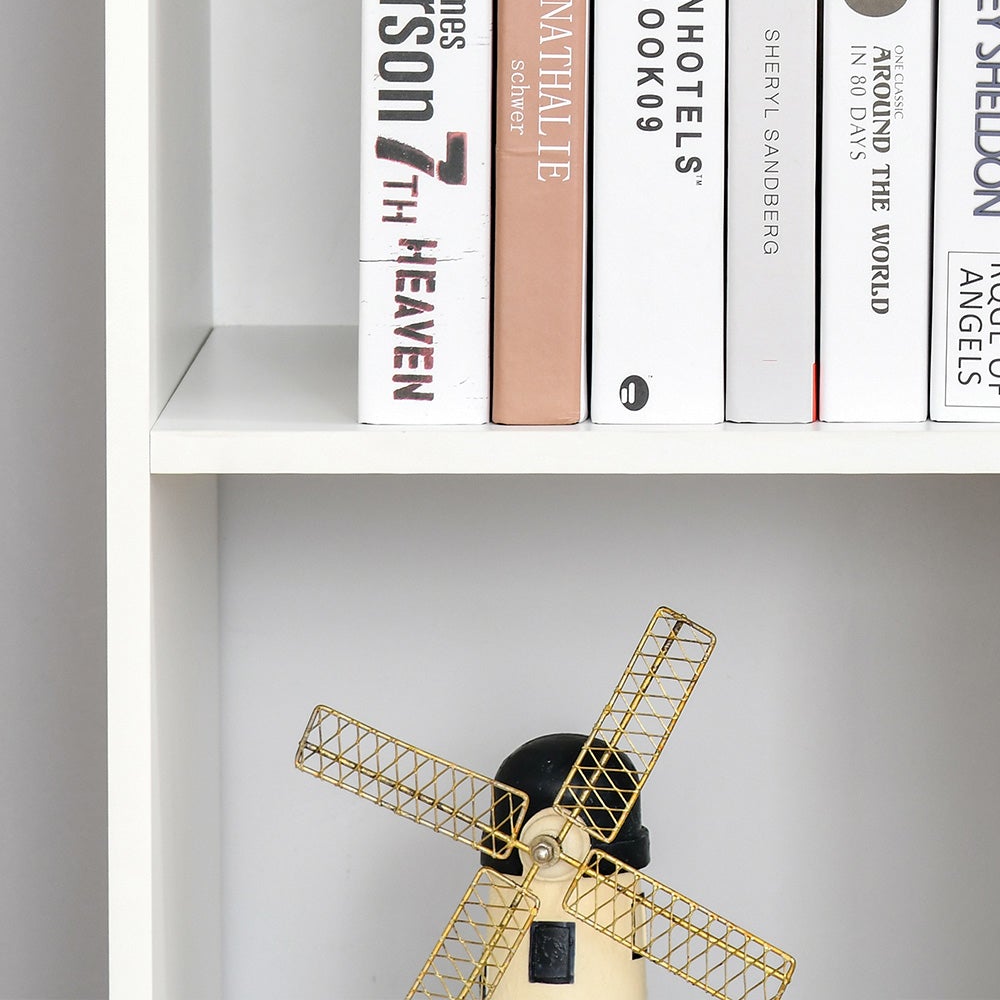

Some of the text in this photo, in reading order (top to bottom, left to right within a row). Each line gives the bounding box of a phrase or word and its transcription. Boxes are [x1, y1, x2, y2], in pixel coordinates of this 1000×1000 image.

[510, 60, 530, 136] schwer
[537, 0, 573, 182] NATHALIE
[763, 29, 780, 254] SHERYL SANDBERG
[850, 46, 867, 160] IN 80 DAYS
[894, 45, 904, 119] ONE CLASSIC
[871, 46, 891, 314] AROUND THE WORLD
[393, 238, 438, 401] HEAVEN
[958, 268, 983, 385] ANGELS
